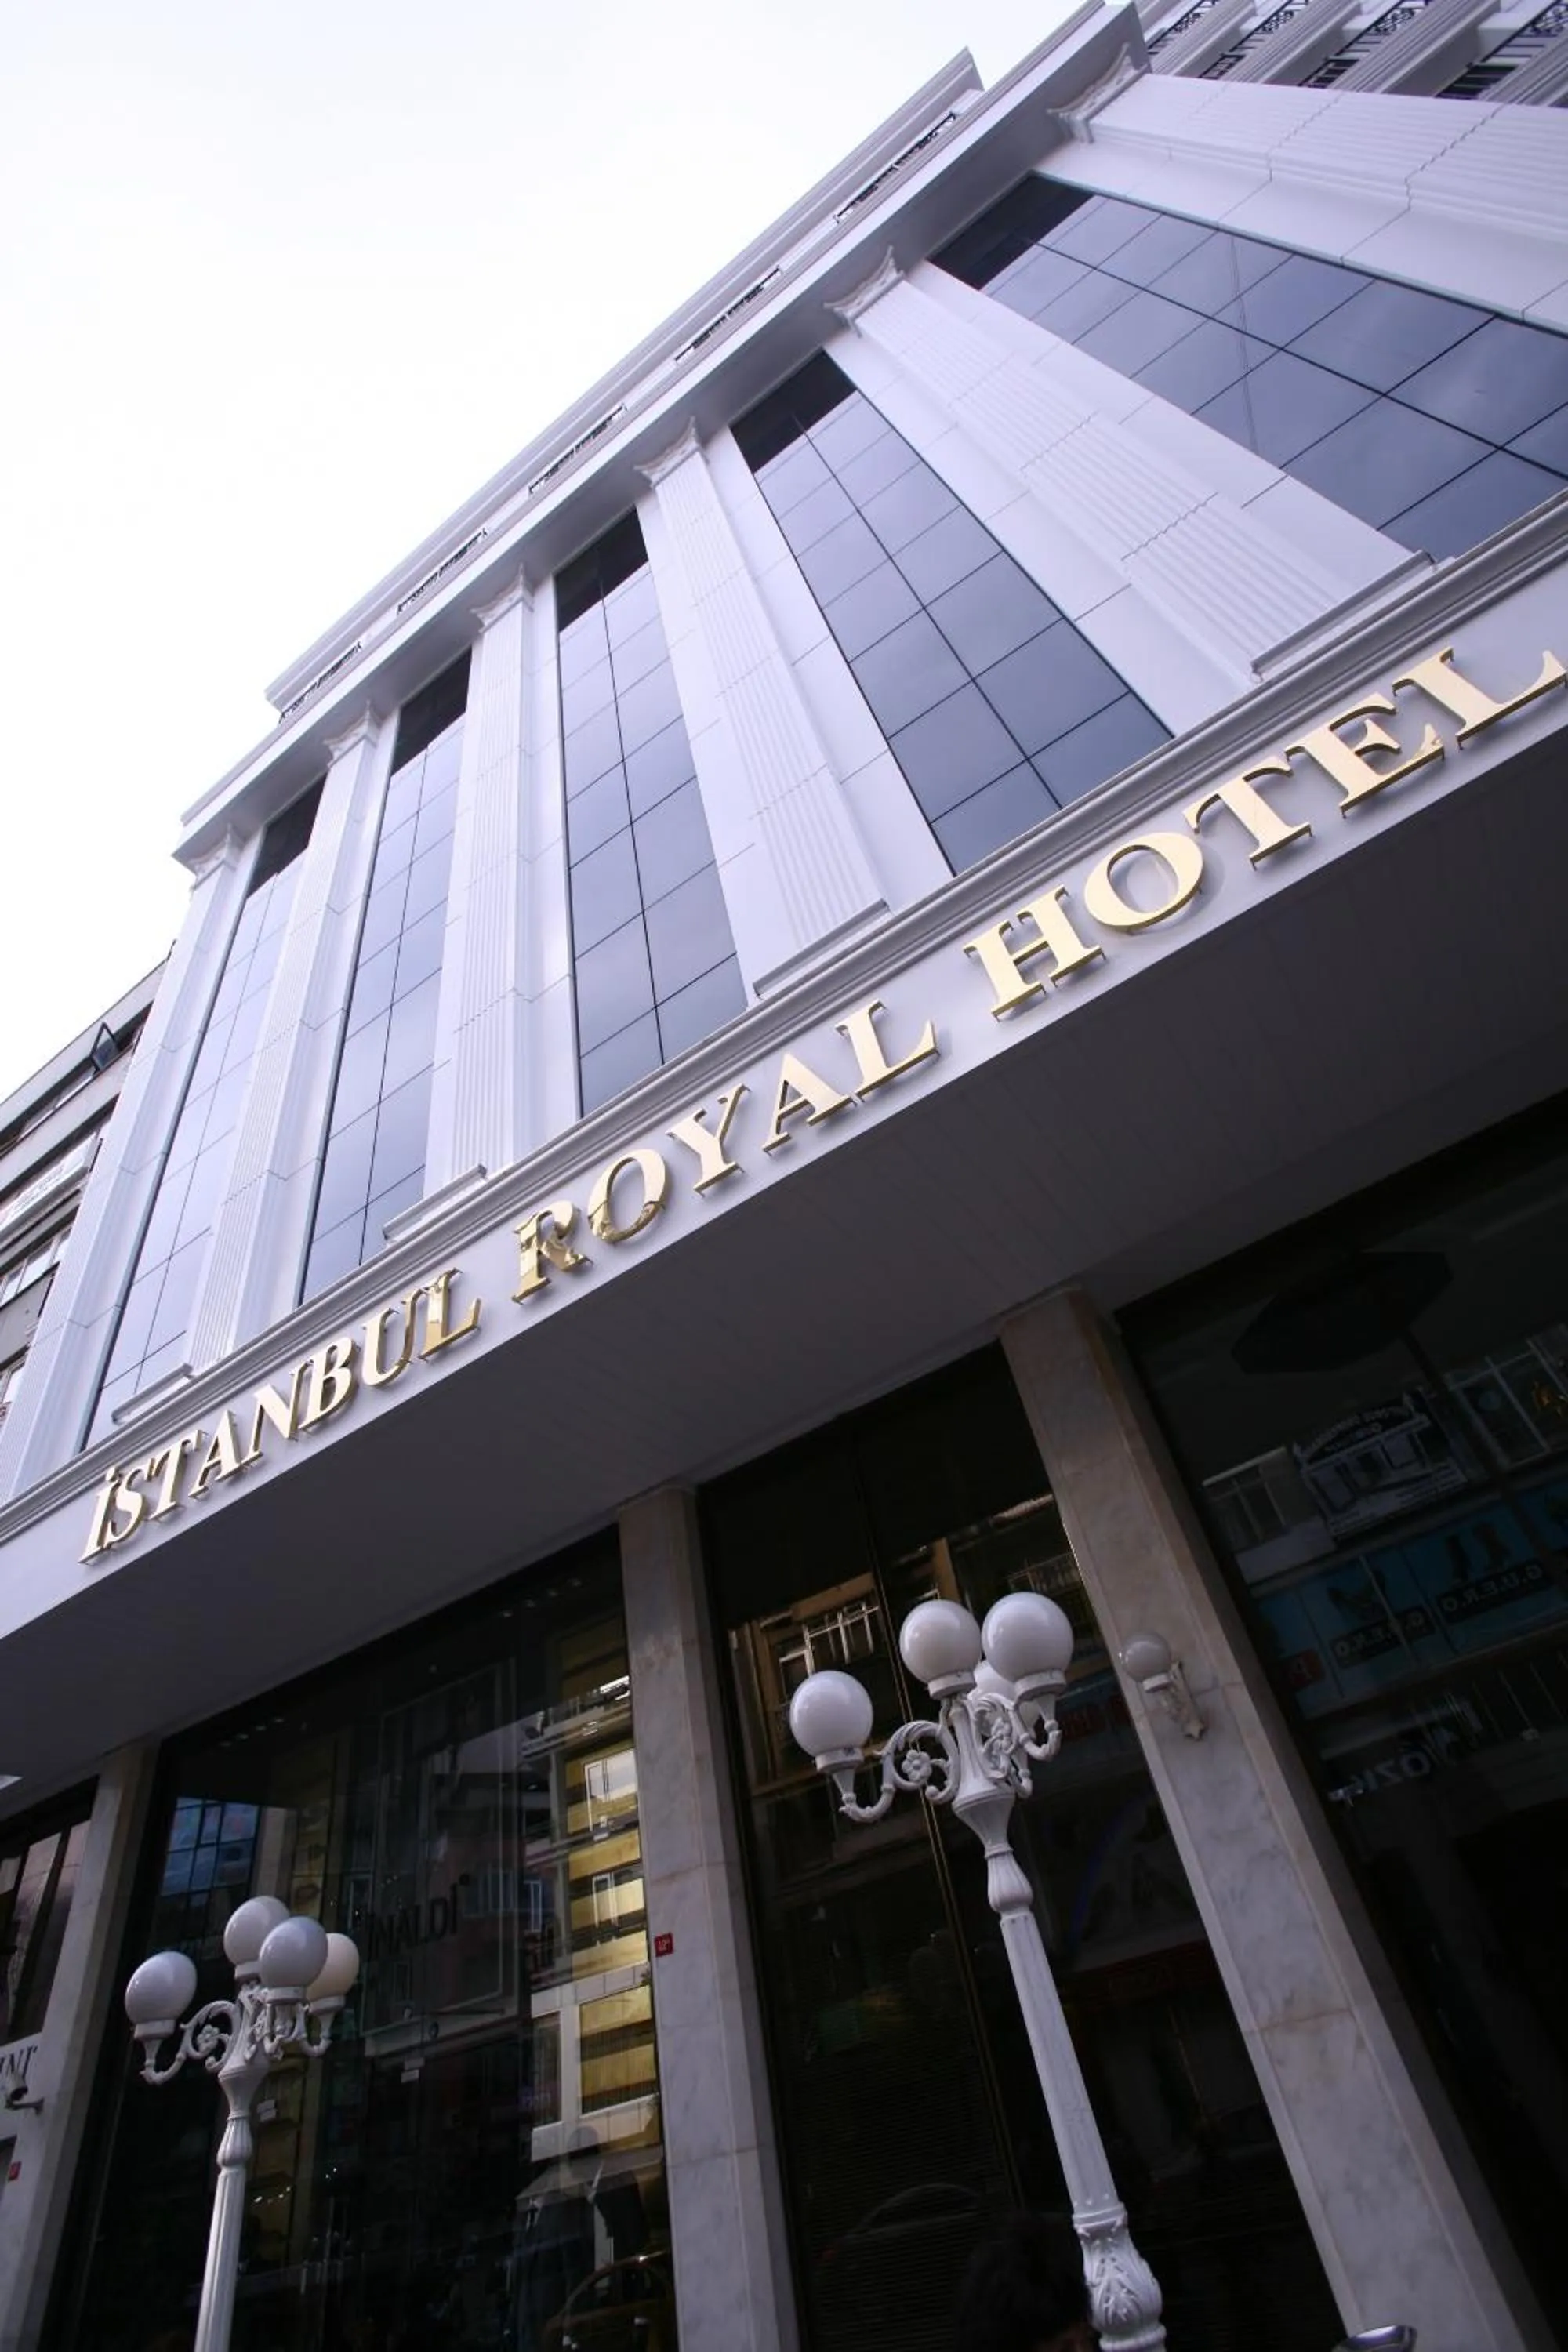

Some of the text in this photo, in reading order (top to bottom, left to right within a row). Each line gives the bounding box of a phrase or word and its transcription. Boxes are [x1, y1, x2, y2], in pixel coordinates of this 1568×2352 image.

[79, 647, 1568, 1564] İSTANBUL ROYAL HOTEL
